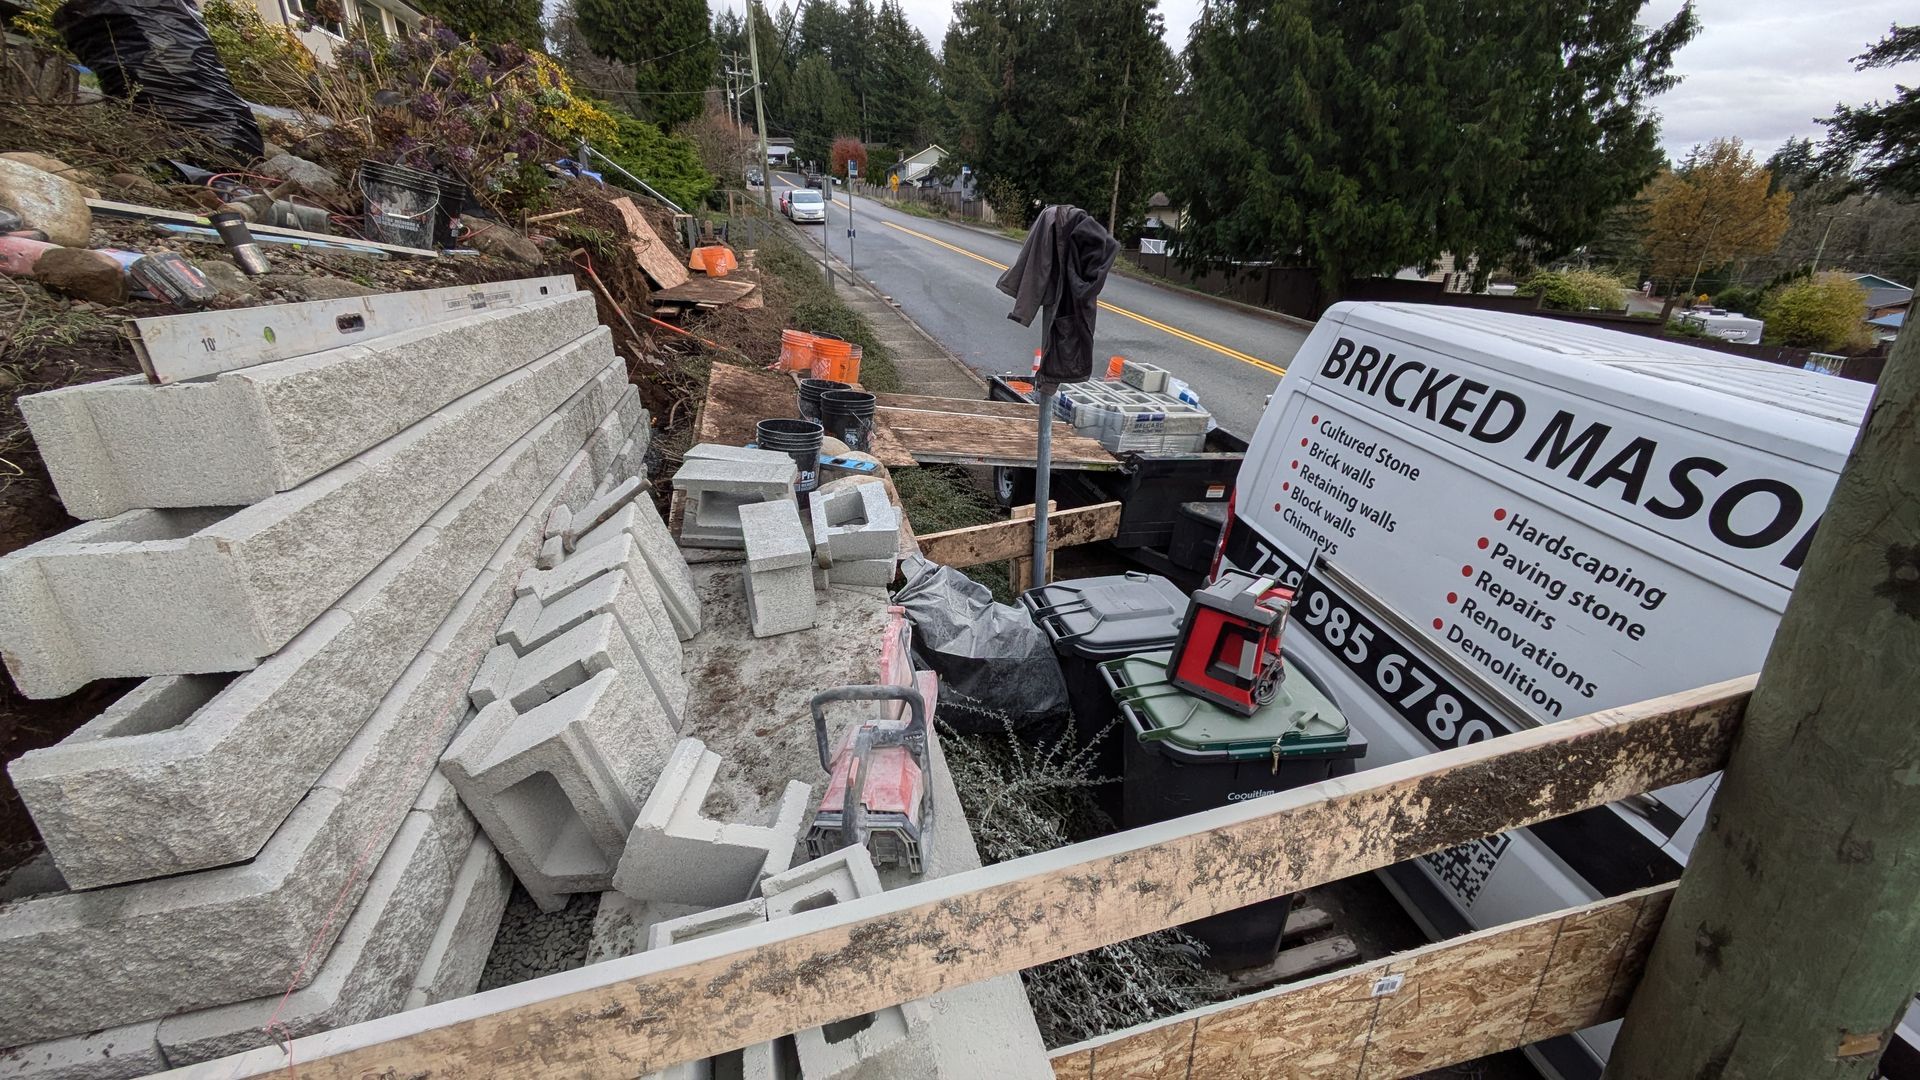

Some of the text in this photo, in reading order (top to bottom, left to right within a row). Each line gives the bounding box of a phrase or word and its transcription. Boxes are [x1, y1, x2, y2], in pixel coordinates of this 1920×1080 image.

[1320, 336, 1527, 445] BRICKED
[801, 470, 815, 480] Pro
[1308, 441, 1376, 490] Brick walls
[1319, 419, 1421, 482] Cultured Stone
[1283, 507, 1338, 556] Chimneys
[1290, 485, 1357, 539] Block walls
[1299, 463, 1397, 534] Retaining walls
[1489, 542, 1646, 642] Paving stone
[1506, 513, 1668, 611] Hardscaping
[1305, 591, 1374, 664] 985
[1474, 569, 1557, 632] Repairs
[1446, 623, 1563, 718] Demolition
[1459, 597, 1599, 699] Renovations
